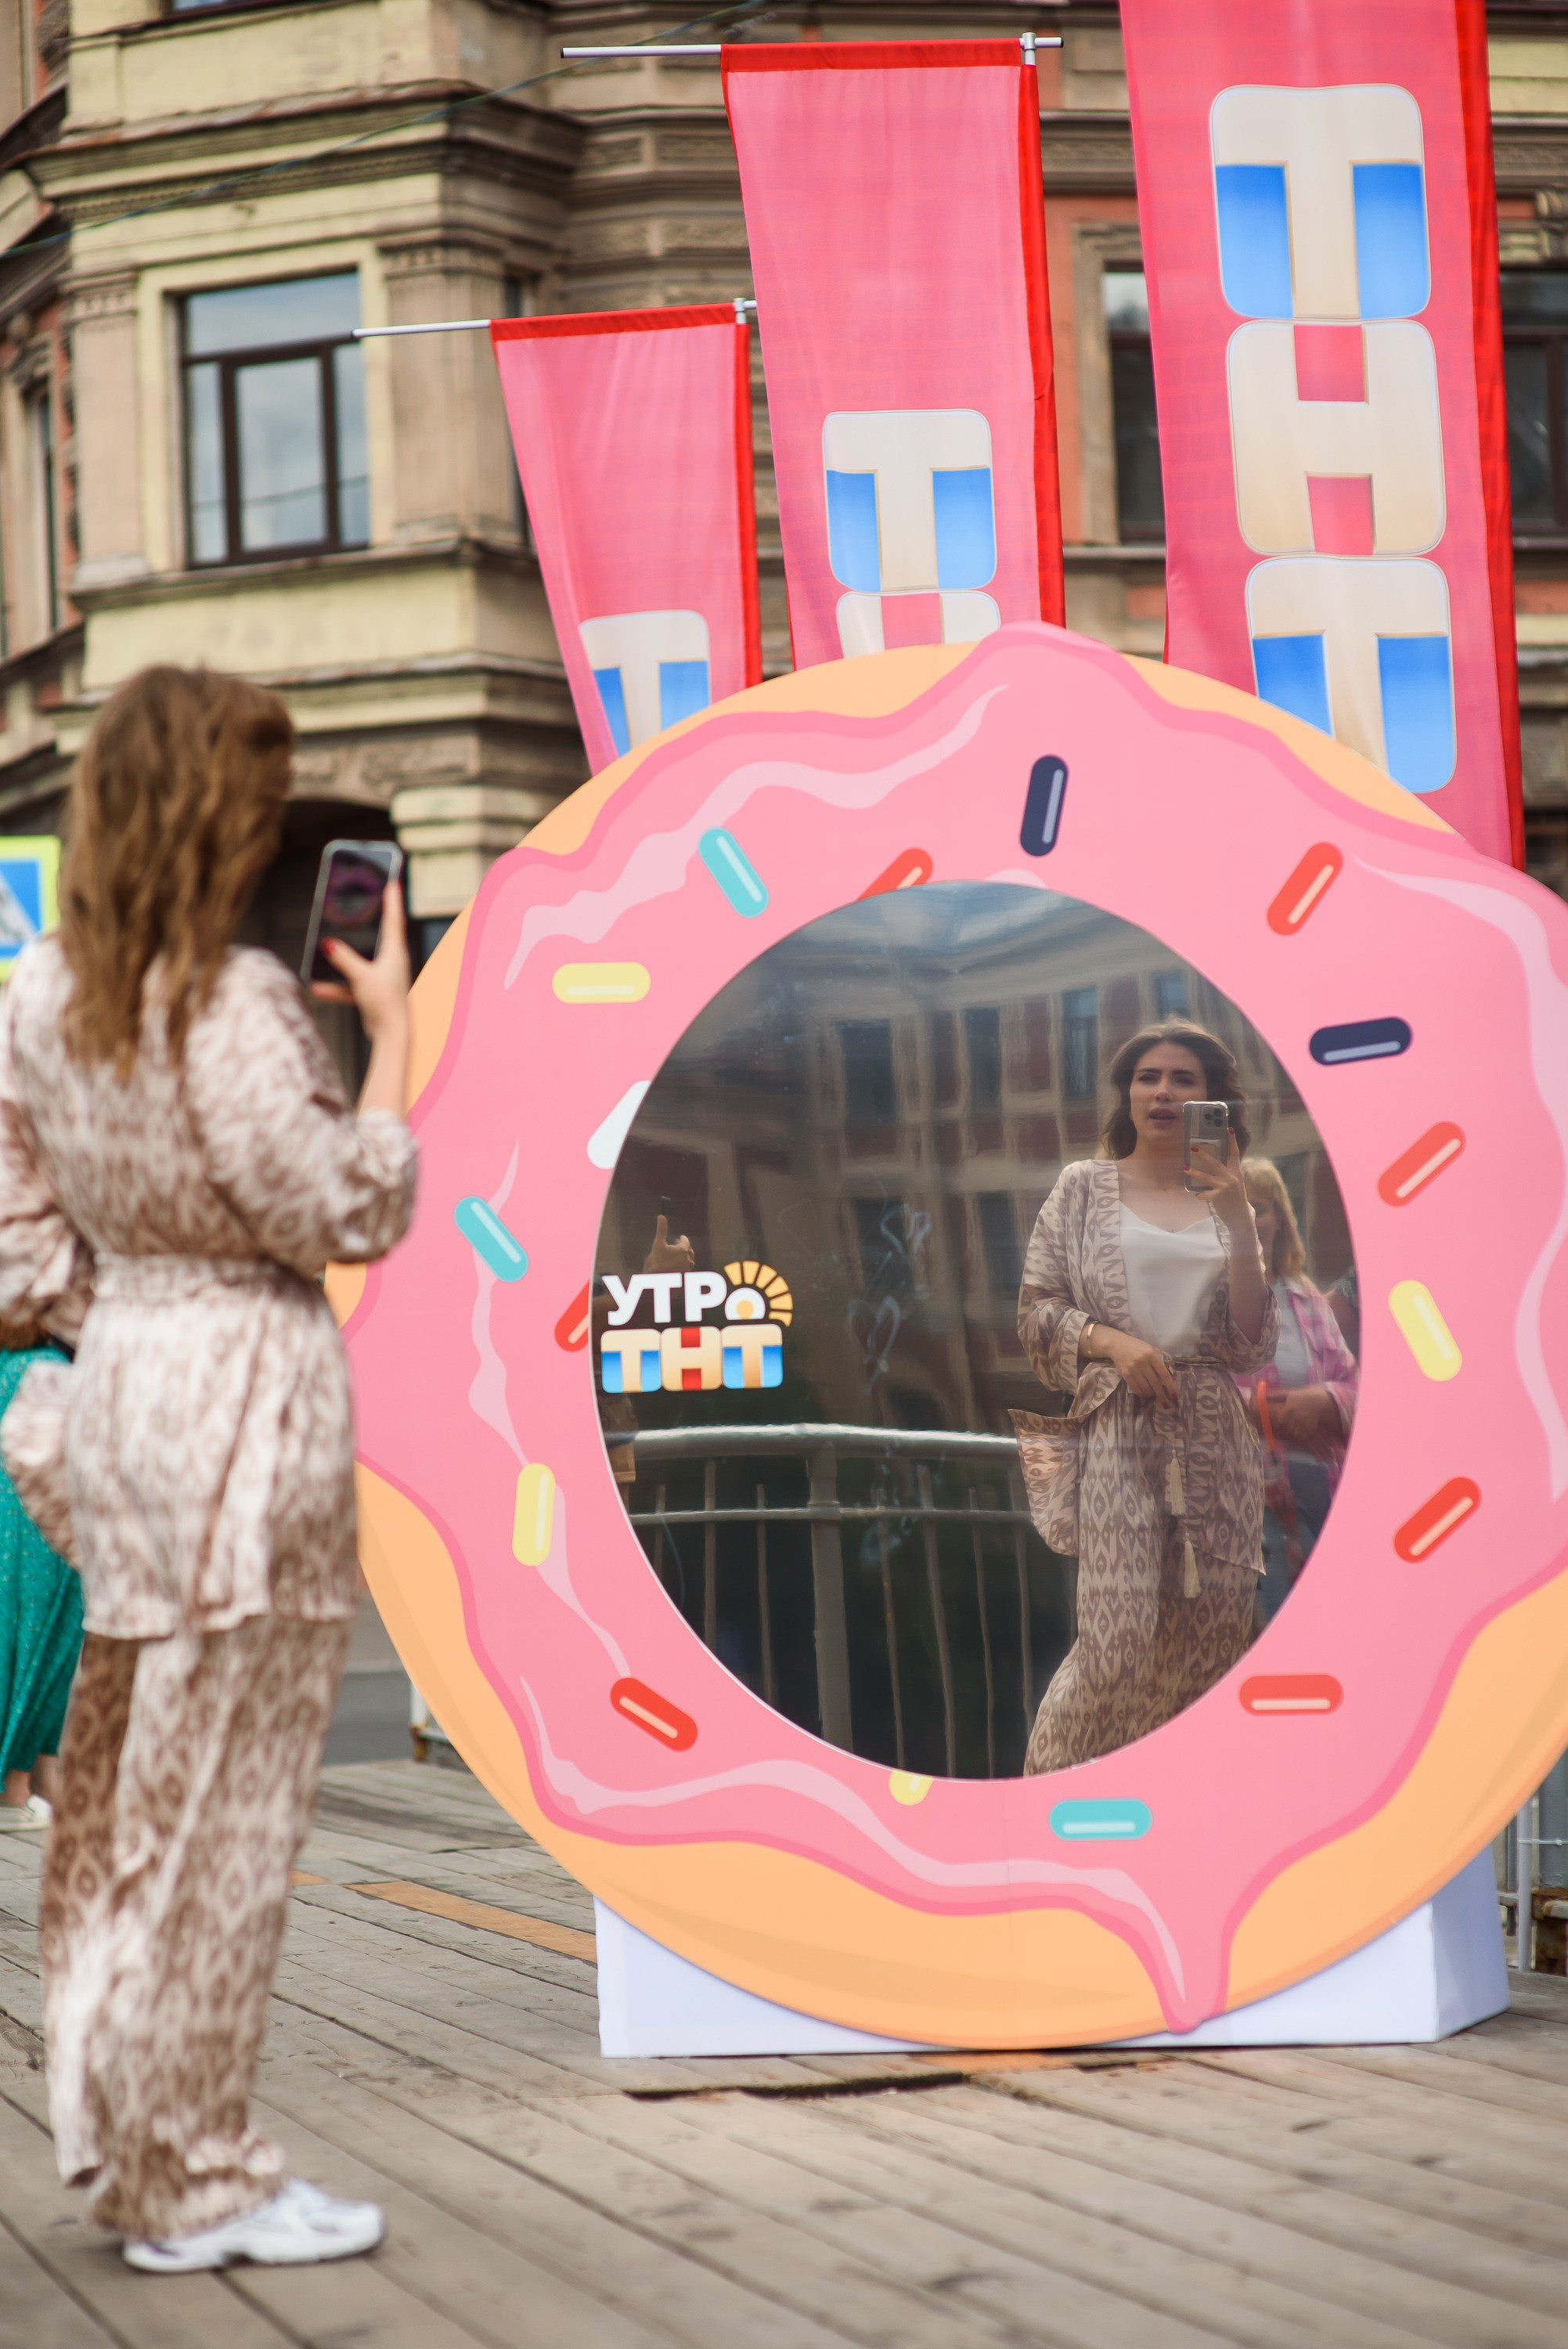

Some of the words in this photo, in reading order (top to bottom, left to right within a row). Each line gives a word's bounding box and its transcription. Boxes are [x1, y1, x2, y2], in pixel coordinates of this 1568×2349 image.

[1209, 83, 1458, 793] ТНТ
[601, 1262, 792, 1326] УТРО
[600, 1323, 784, 1394] ТНТ
